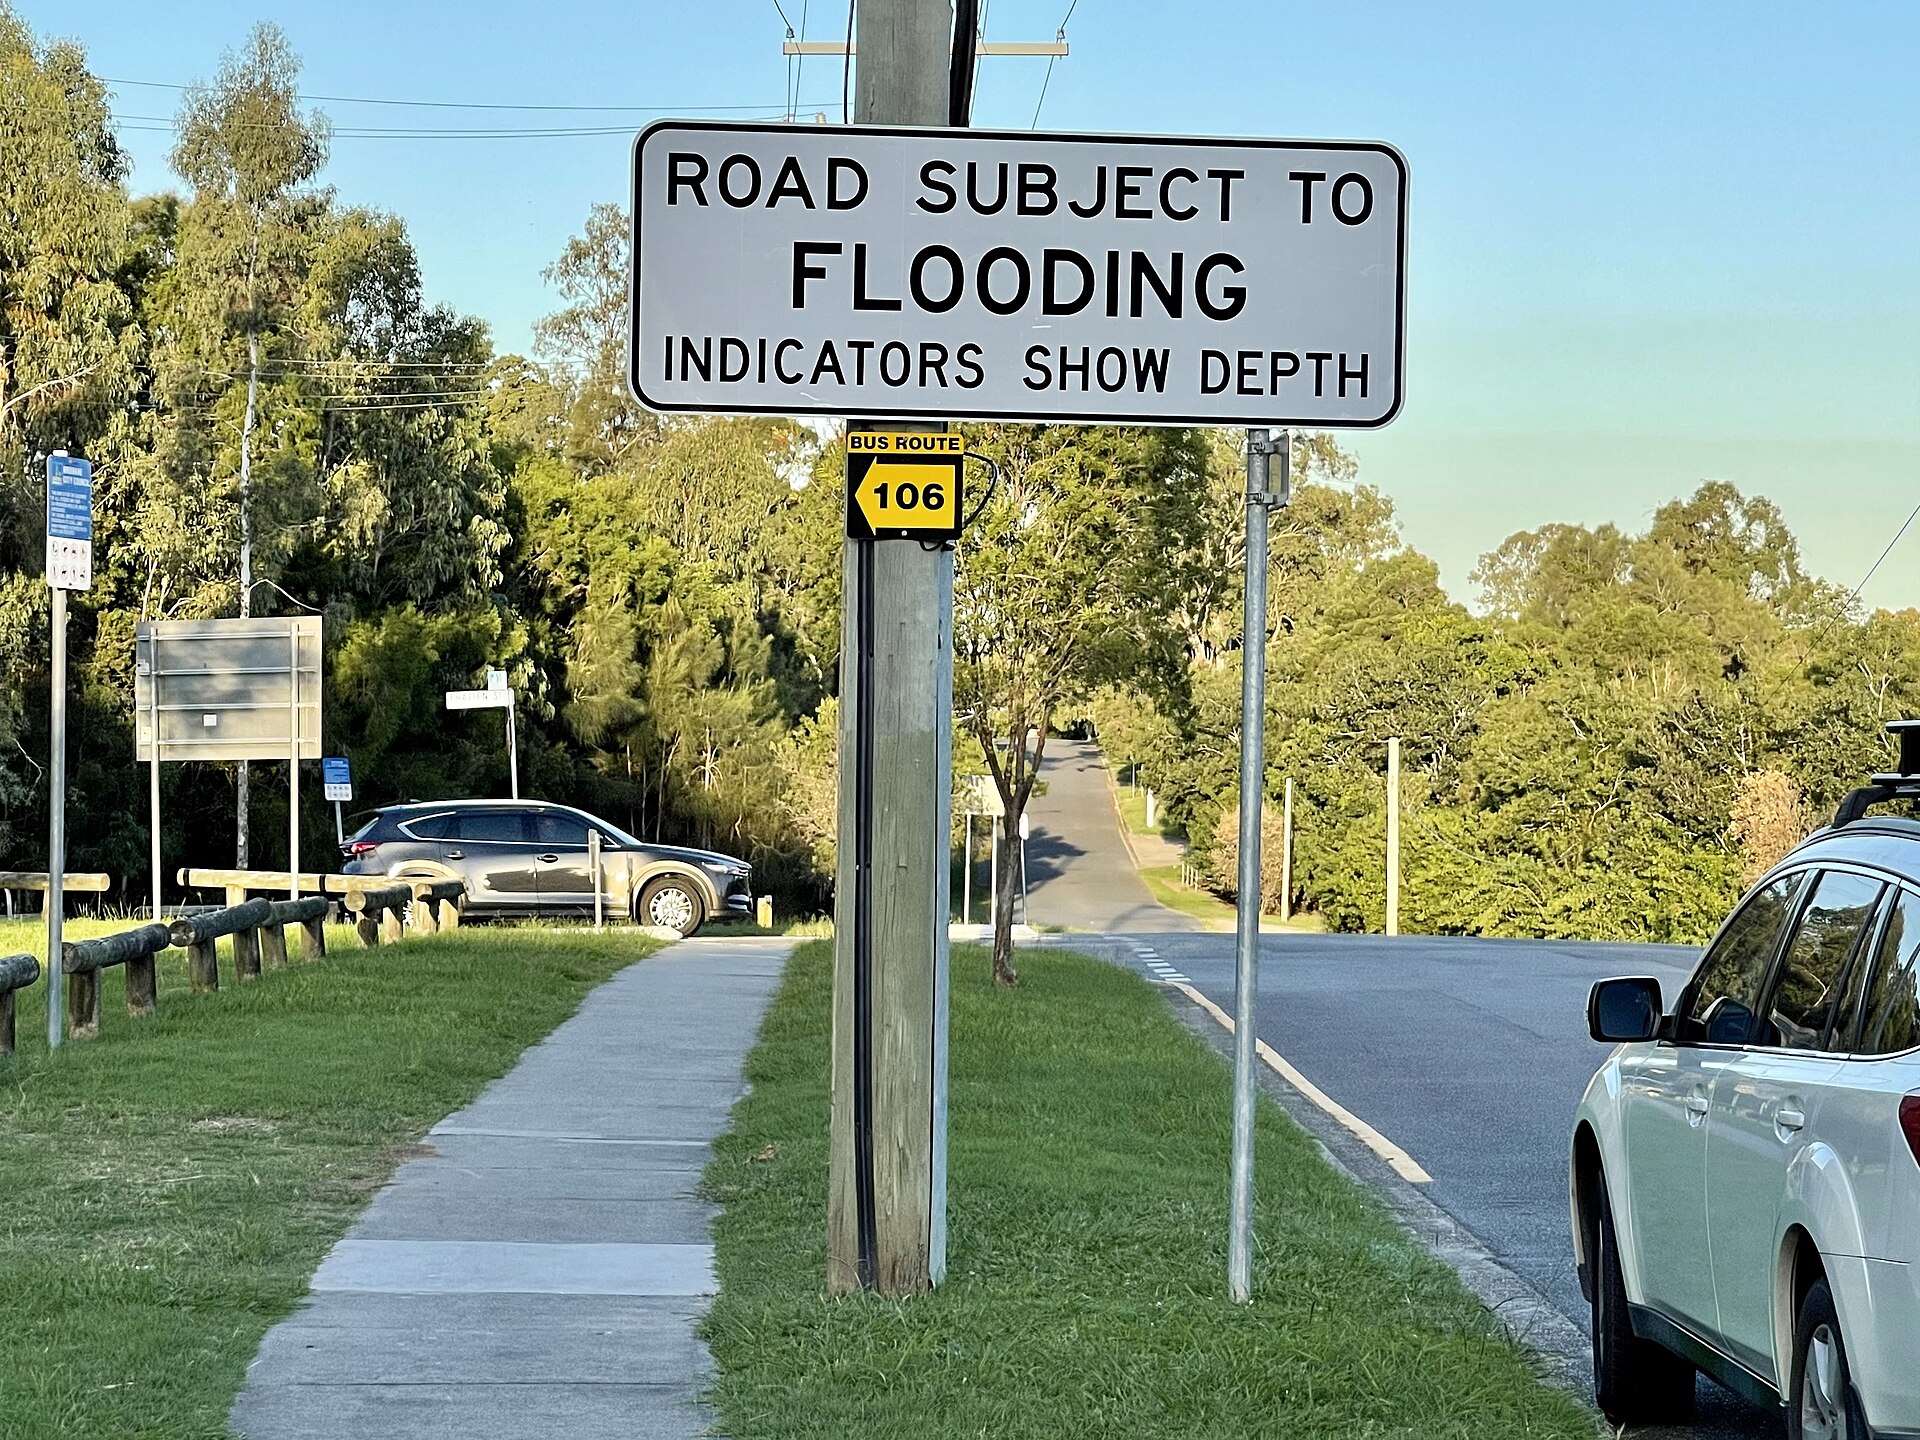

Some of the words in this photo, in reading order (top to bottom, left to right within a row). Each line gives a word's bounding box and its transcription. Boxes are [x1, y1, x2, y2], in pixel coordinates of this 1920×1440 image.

[667, 152, 869, 211] ROAD
[915, 160, 1245, 222] SUBJECT
[1288, 171, 1374, 226] TO
[792, 241, 1247, 321] FLOODING
[664, 335, 985, 389] INDICATORS
[1022, 344, 1171, 393] SHOW
[1200, 349, 1369, 398] DEPTH
[850, 435, 889, 450] BUS
[895, 436, 960, 451] ROUTE
[873, 482, 945, 511] 106
